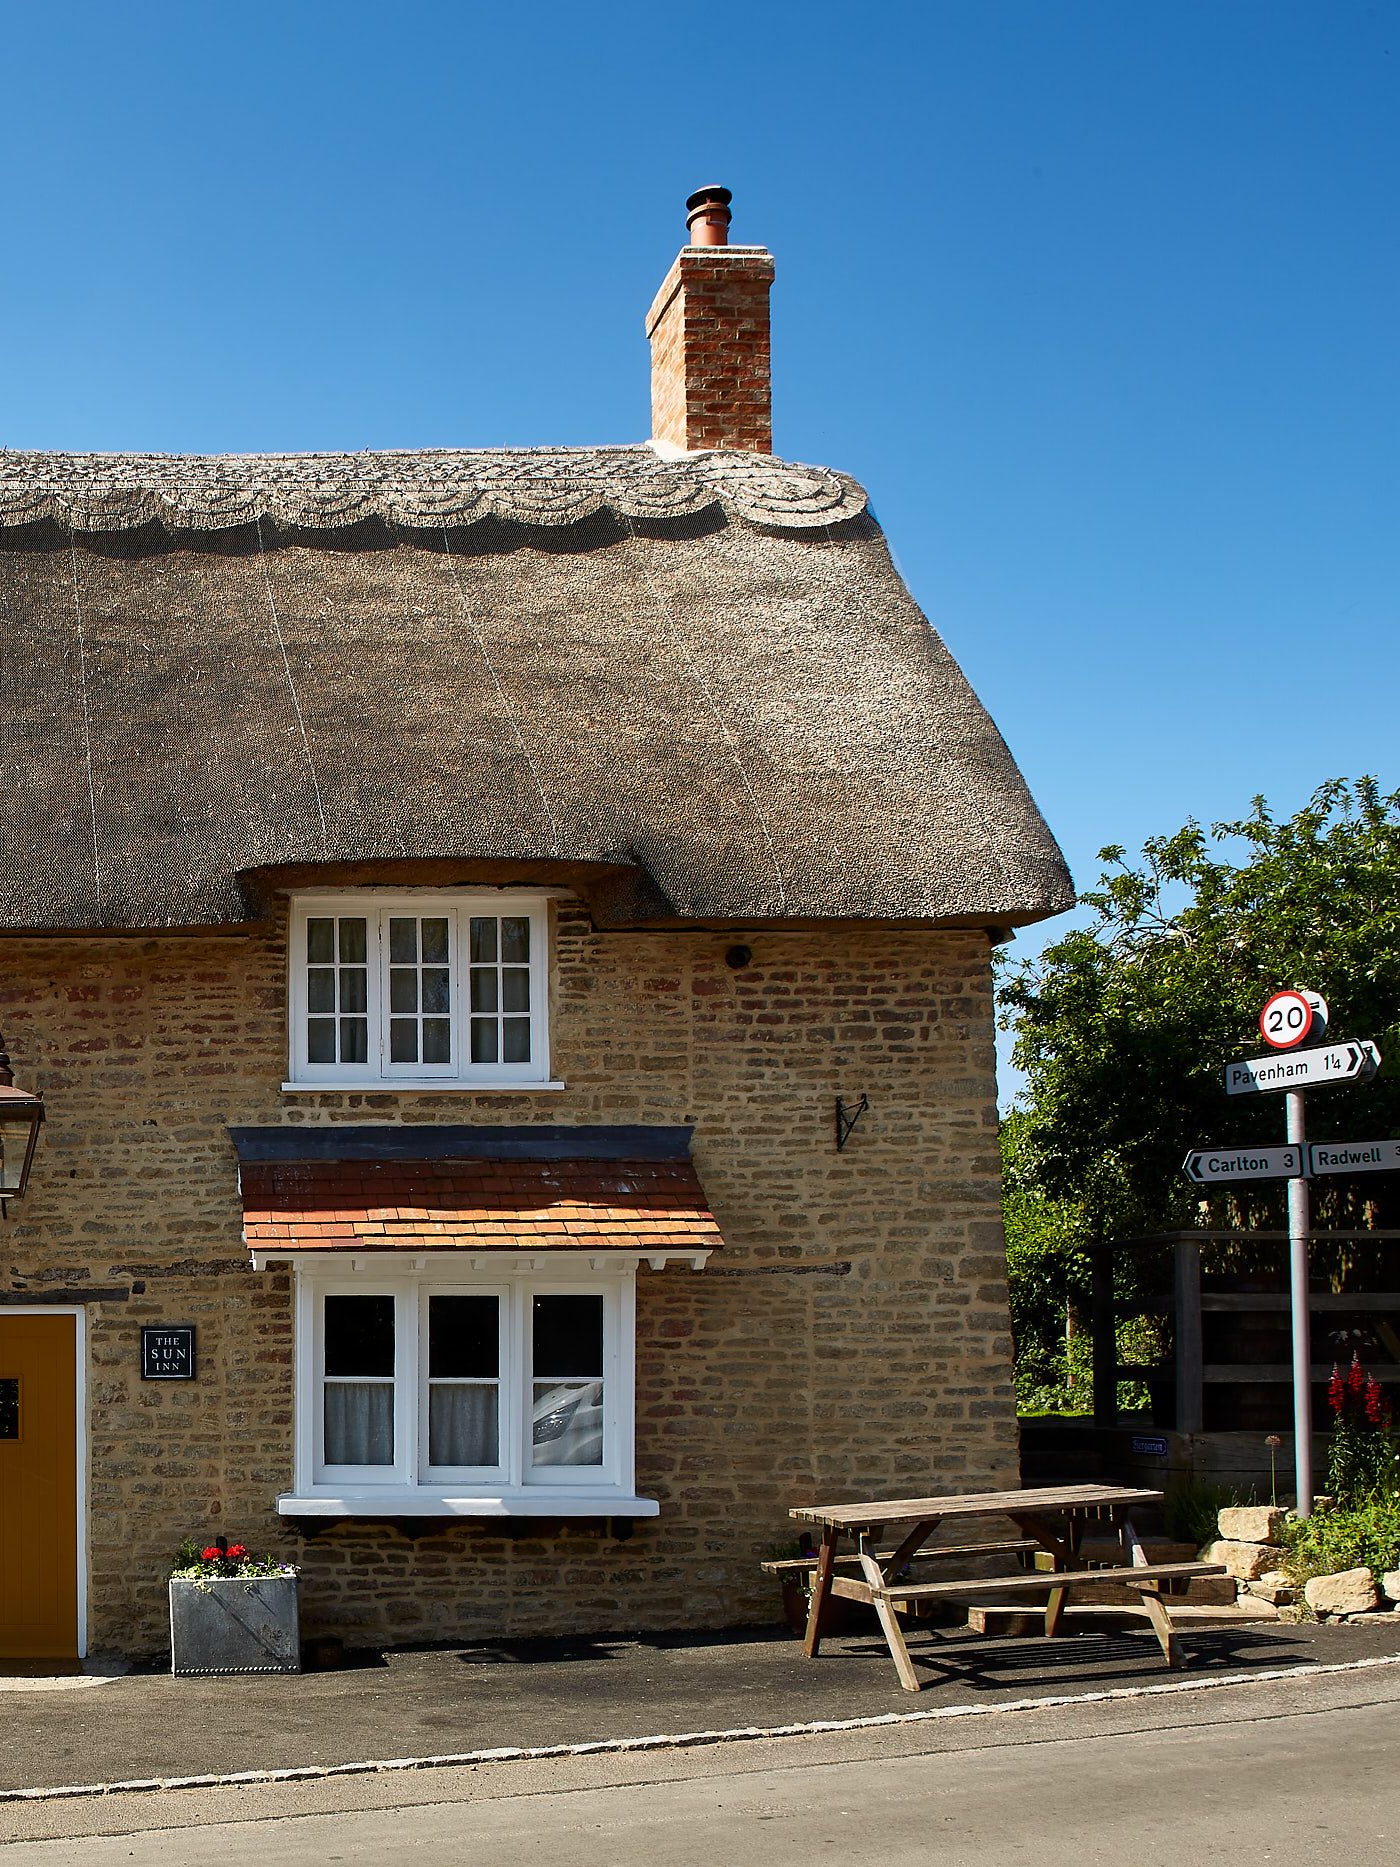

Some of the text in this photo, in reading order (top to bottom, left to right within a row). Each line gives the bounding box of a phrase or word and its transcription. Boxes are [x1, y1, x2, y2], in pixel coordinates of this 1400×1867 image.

[1269, 1006, 1303, 1032] 20
[1232, 1062, 1308, 1085] Pavenham
[1208, 1153, 1294, 1173] Carlton 3
[1318, 1148, 1382, 1165] Radwell
[155, 1337, 180, 1346] THE
[151, 1348, 186, 1359] SUN
[156, 1362, 180, 1371] INN
